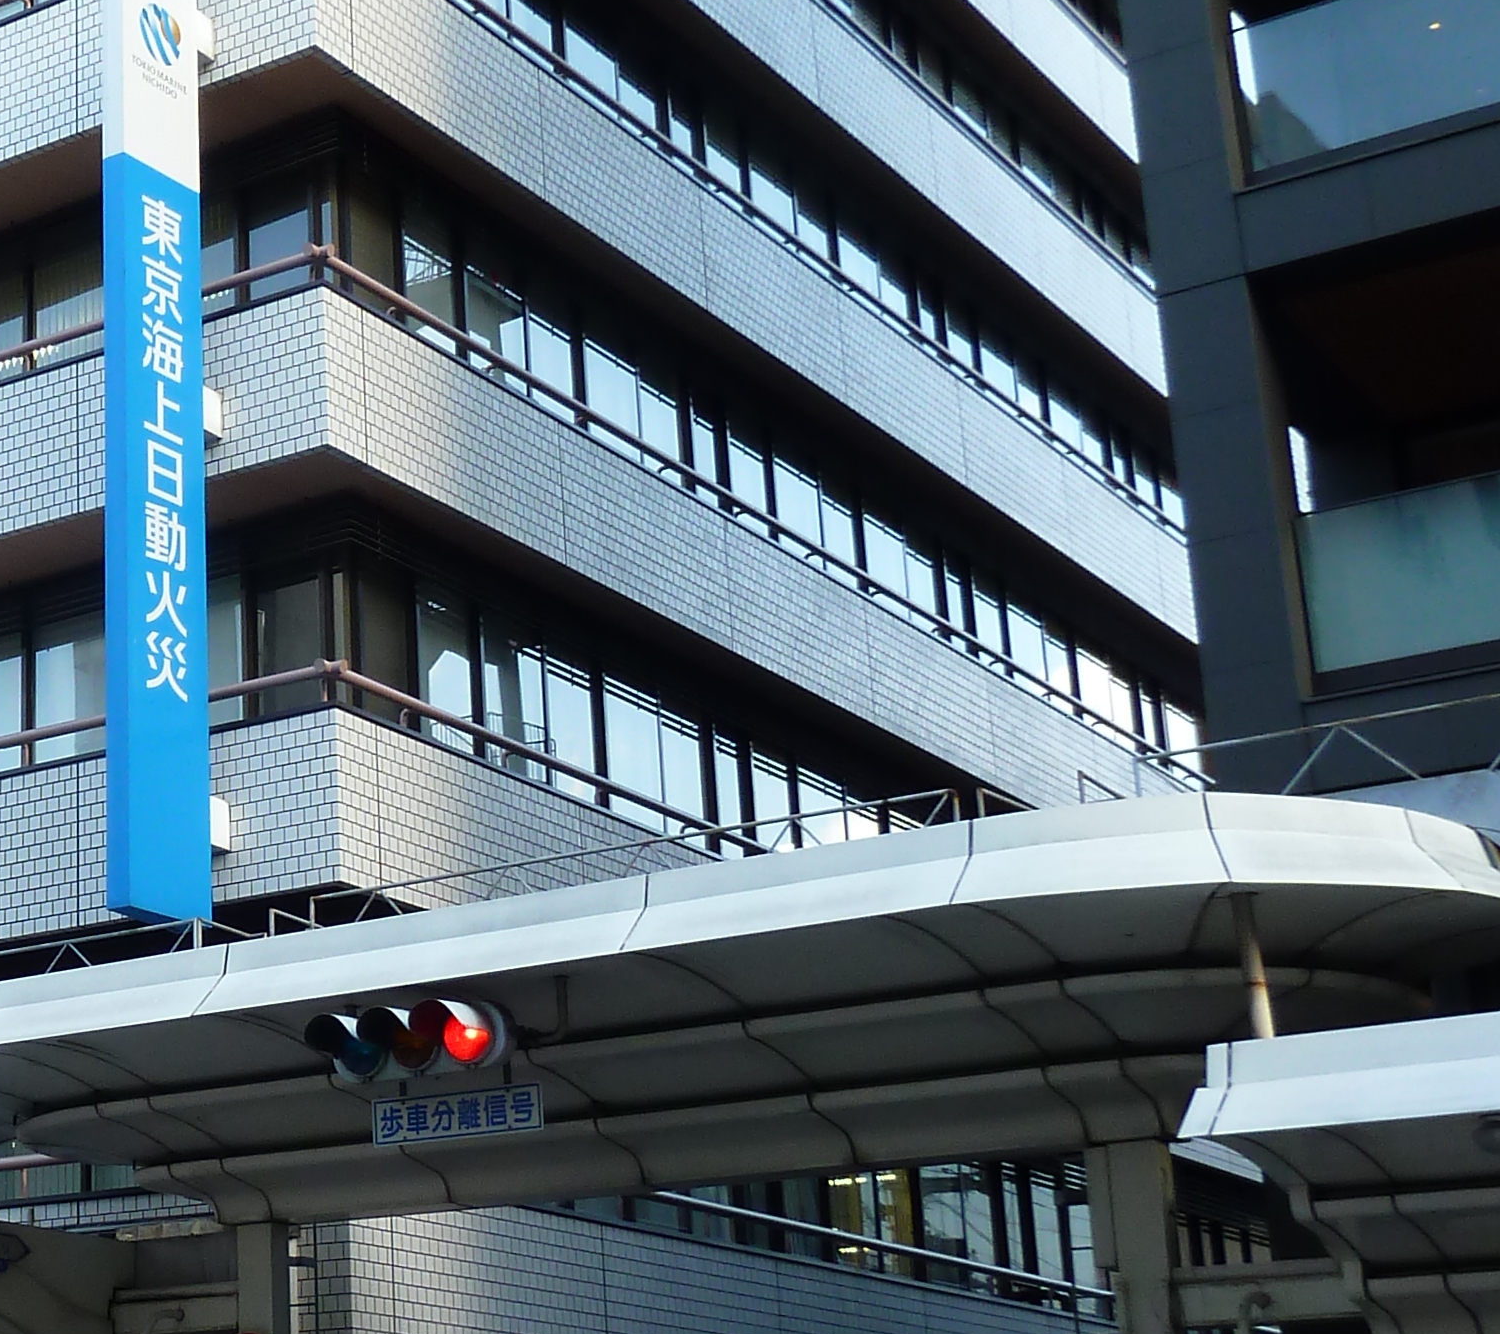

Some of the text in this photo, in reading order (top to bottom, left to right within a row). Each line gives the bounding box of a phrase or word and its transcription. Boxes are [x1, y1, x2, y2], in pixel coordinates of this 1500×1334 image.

[131, 54, 187, 95] TOKIO MARINE
[142, 72, 178, 99] NICHIDO
[141, 194, 189, 703] 東京海上日動火災
[380, 1091, 534, 1139] 歩車分離信号
